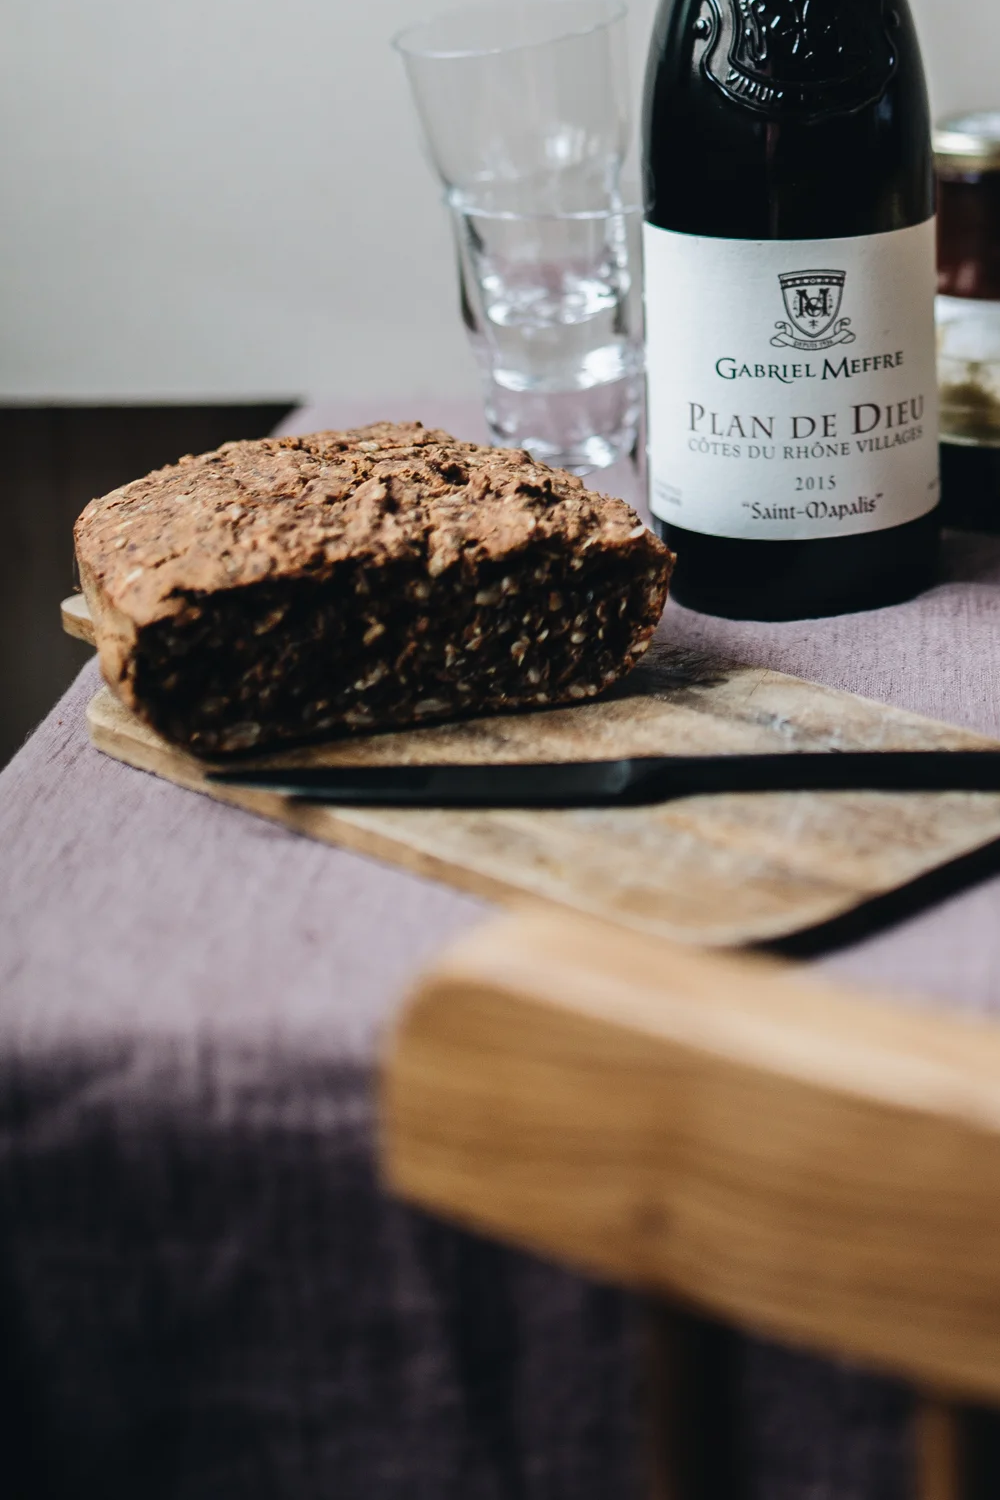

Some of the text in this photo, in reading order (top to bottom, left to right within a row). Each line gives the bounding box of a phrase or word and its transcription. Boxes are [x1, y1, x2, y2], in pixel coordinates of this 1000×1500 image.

[715, 351, 904, 384] GABRIEL MEFFRE
[688, 394, 925, 440] PLAN DE DIEU
[688, 425, 923, 461] CÔTES DU RHÔNE VILLAGES
[795, 475, 837, 491] 2015
